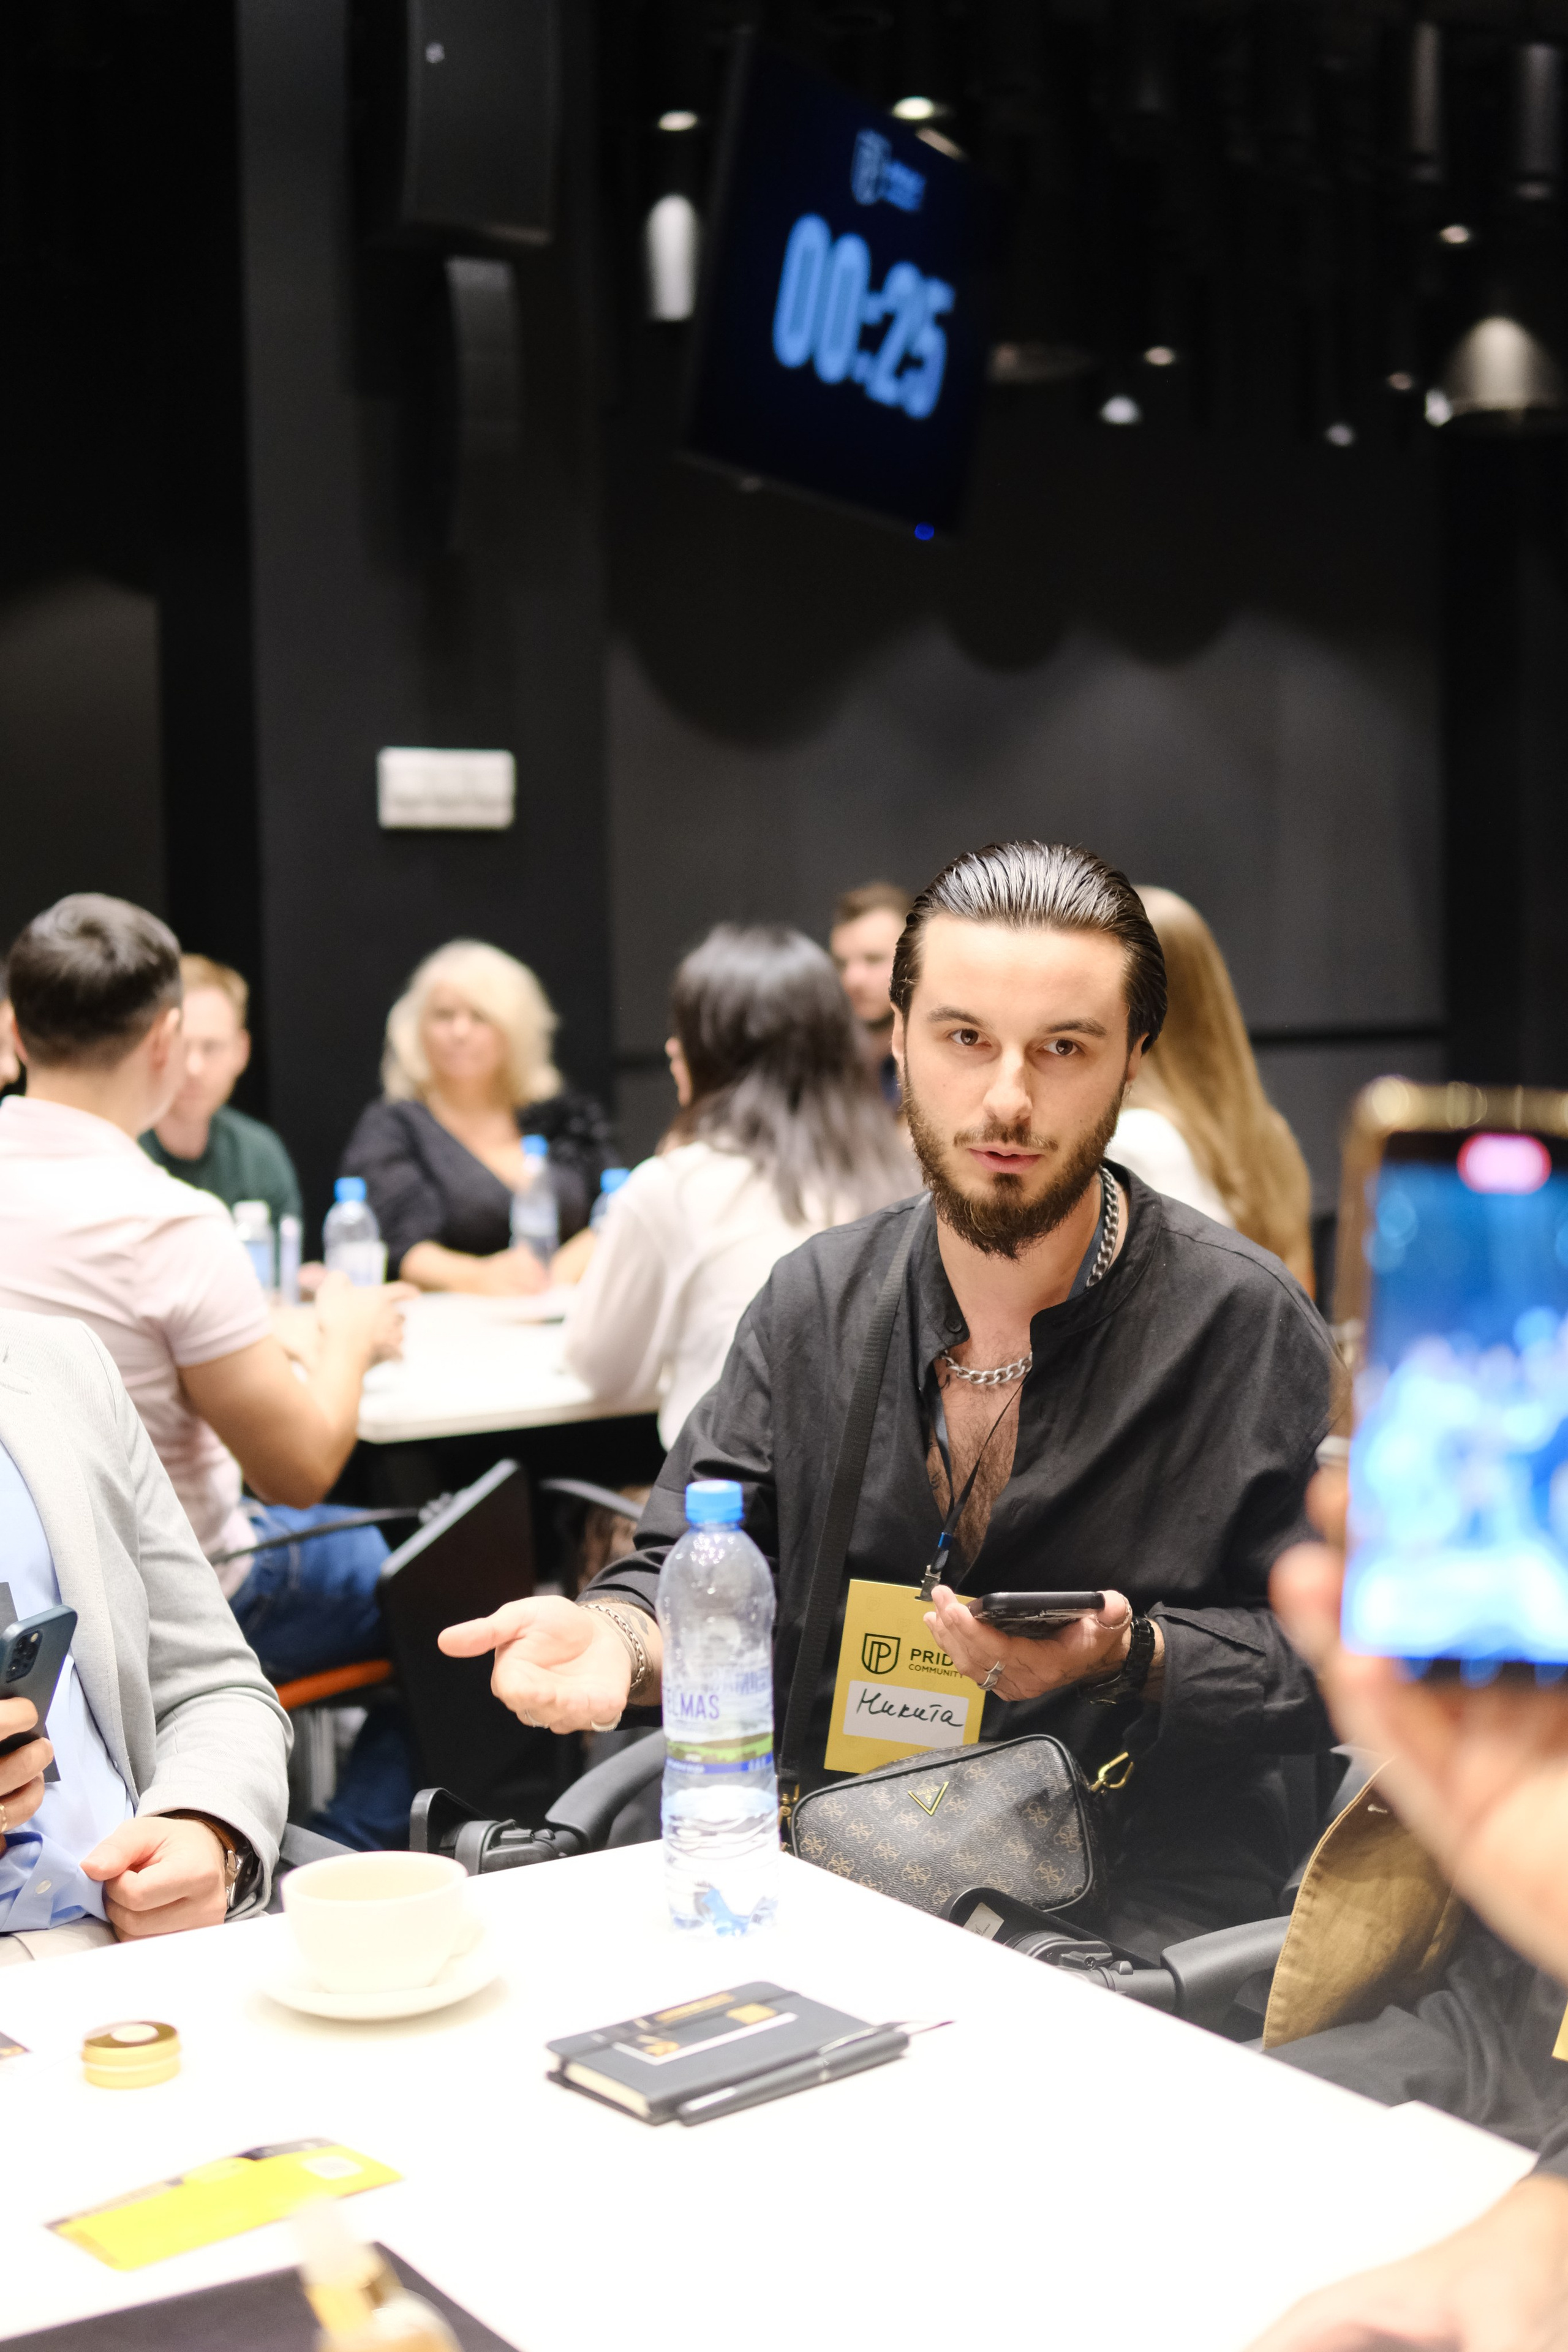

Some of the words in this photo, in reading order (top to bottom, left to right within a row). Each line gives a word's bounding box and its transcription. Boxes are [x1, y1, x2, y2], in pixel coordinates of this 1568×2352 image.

[773, 213, 955, 420] 00:25
[910, 1648, 954, 1667] PRID
[856, 1689, 964, 1727] Никита
